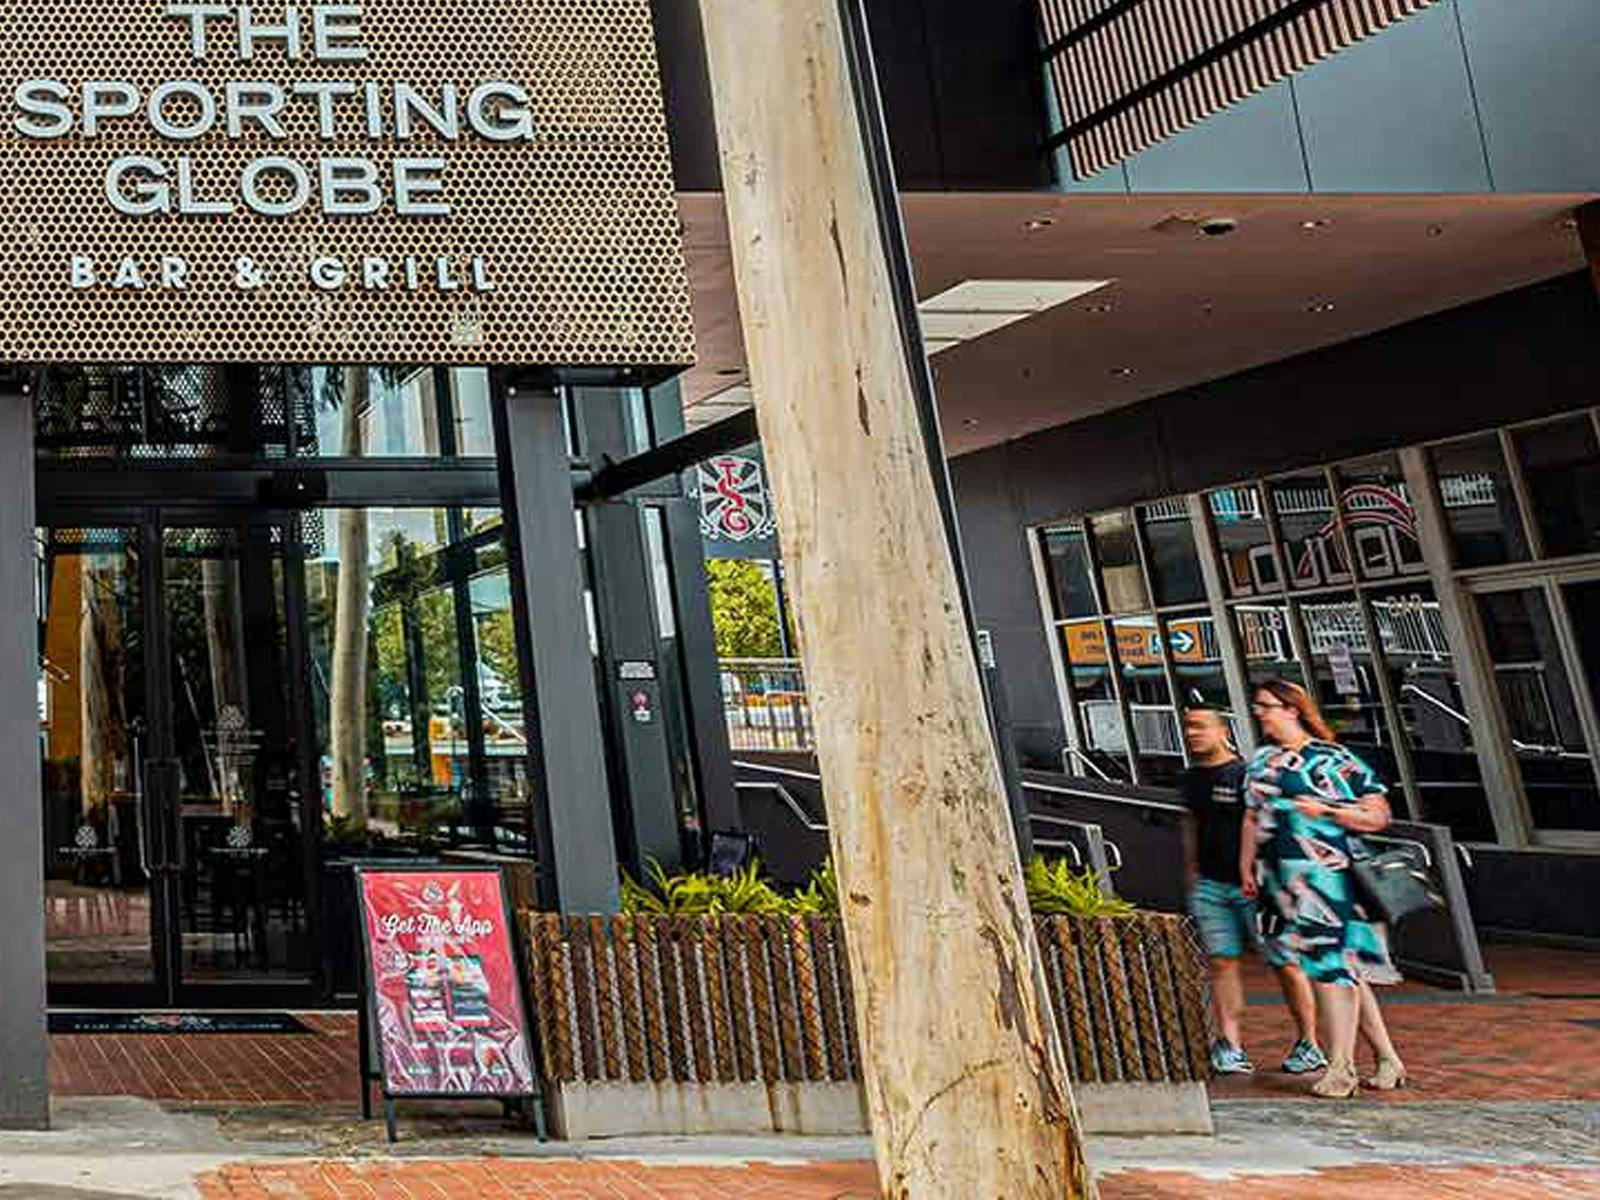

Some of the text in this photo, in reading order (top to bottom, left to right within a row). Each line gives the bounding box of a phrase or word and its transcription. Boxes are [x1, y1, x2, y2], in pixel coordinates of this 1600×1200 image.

[165, 3, 368, 61] THE
[13, 79, 537, 141] SPORTING
[105, 154, 452, 217] GLOBE
[70, 256, 496, 292] BAR & GRILL
[713, 459, 749, 535] TSG
[381, 913, 416, 939] Get
[418, 913, 451, 935] The
